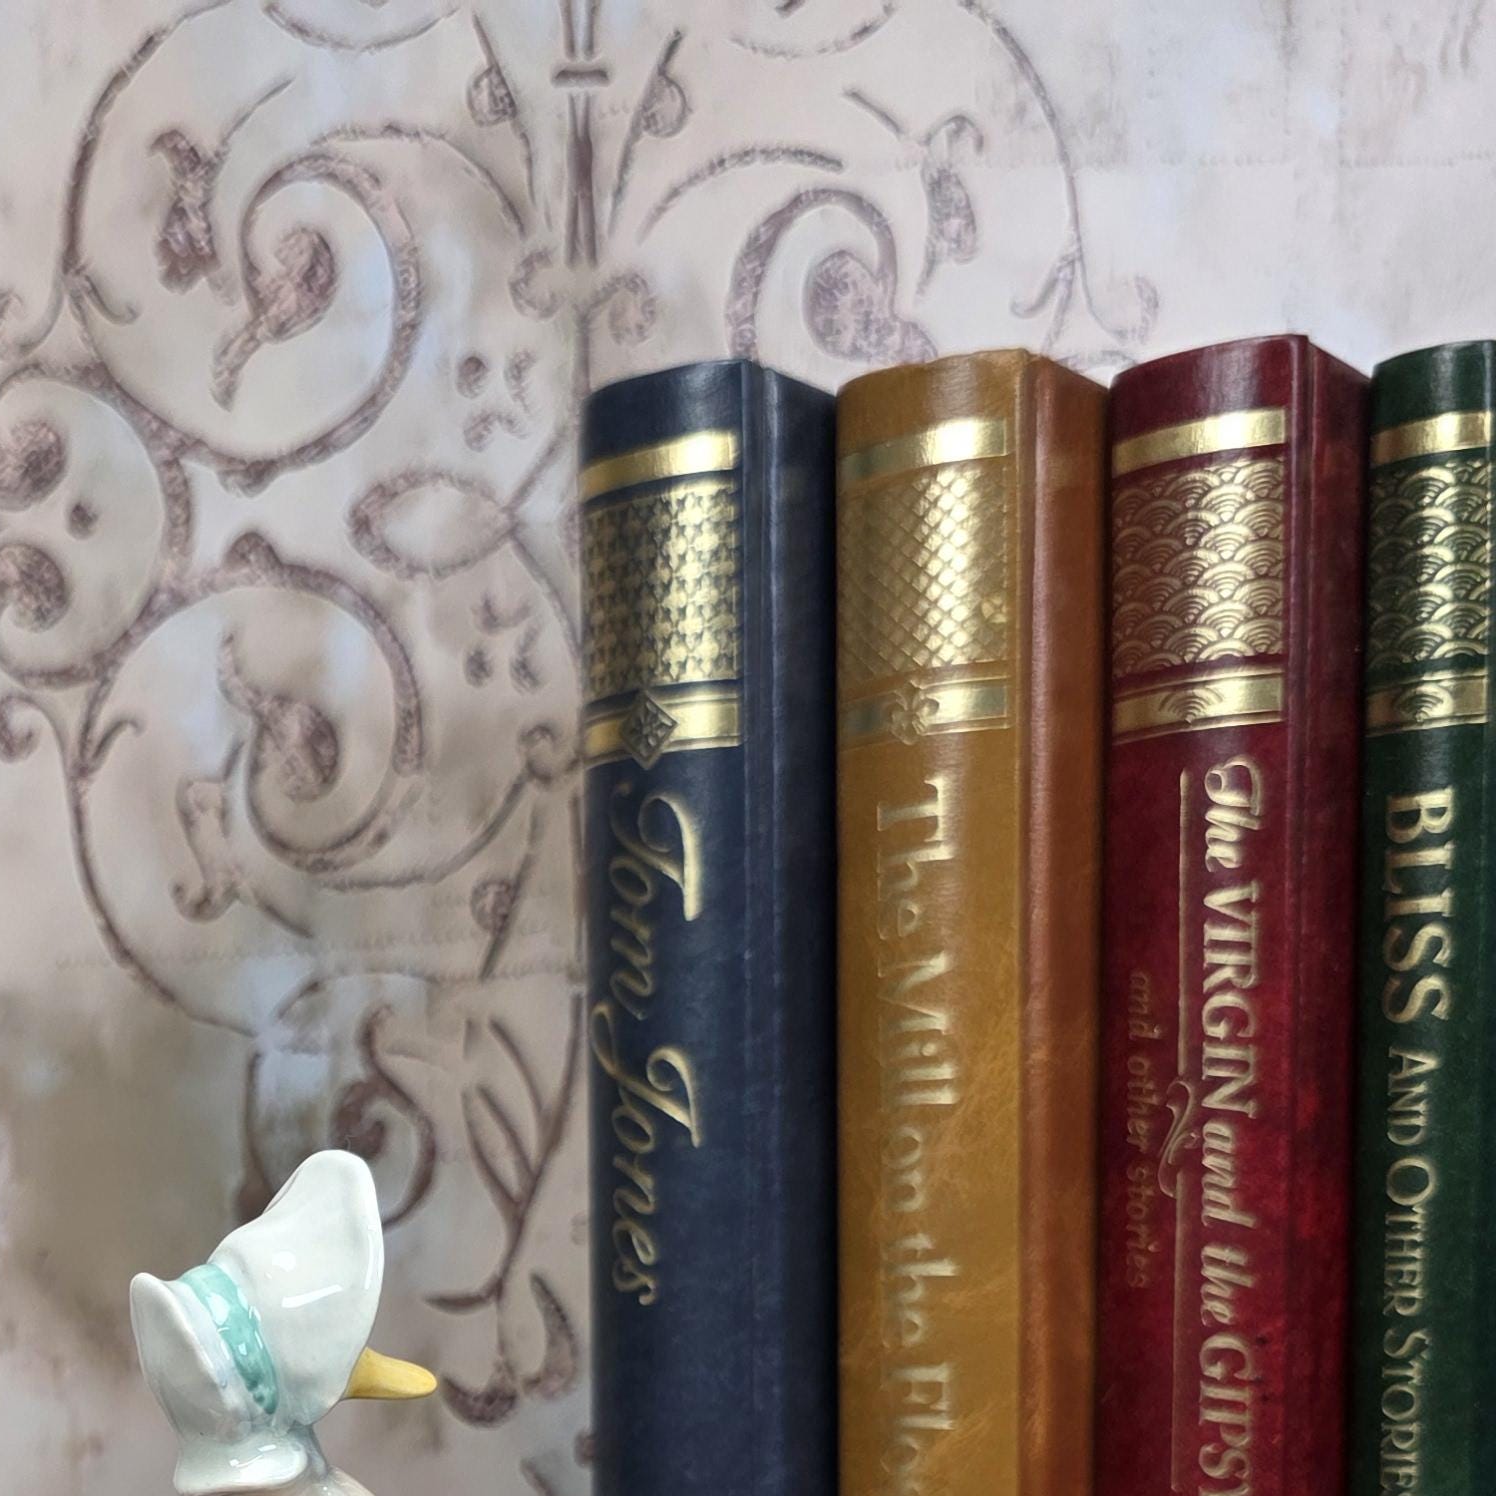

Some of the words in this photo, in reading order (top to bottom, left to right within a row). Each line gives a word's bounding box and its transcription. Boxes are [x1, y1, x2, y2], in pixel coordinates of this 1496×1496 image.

[876, 777, 957, 943] The
[1203, 753, 1263, 873] The
[608, 780, 702, 1021] Tom
[1381, 785, 1455, 1025] BLISS
[1200, 879, 1261, 1121] VIRGIN
[591, 1002, 702, 1306] Jones
[1126, 1054, 1162, 1154] other
[1385, 1045, 1442, 1147] AND
[1125, 1159, 1160, 1289] stories
[1200, 1117, 1259, 1229] and
[880, 1232, 961, 1349] the
[1200, 1242, 1257, 1328] the
